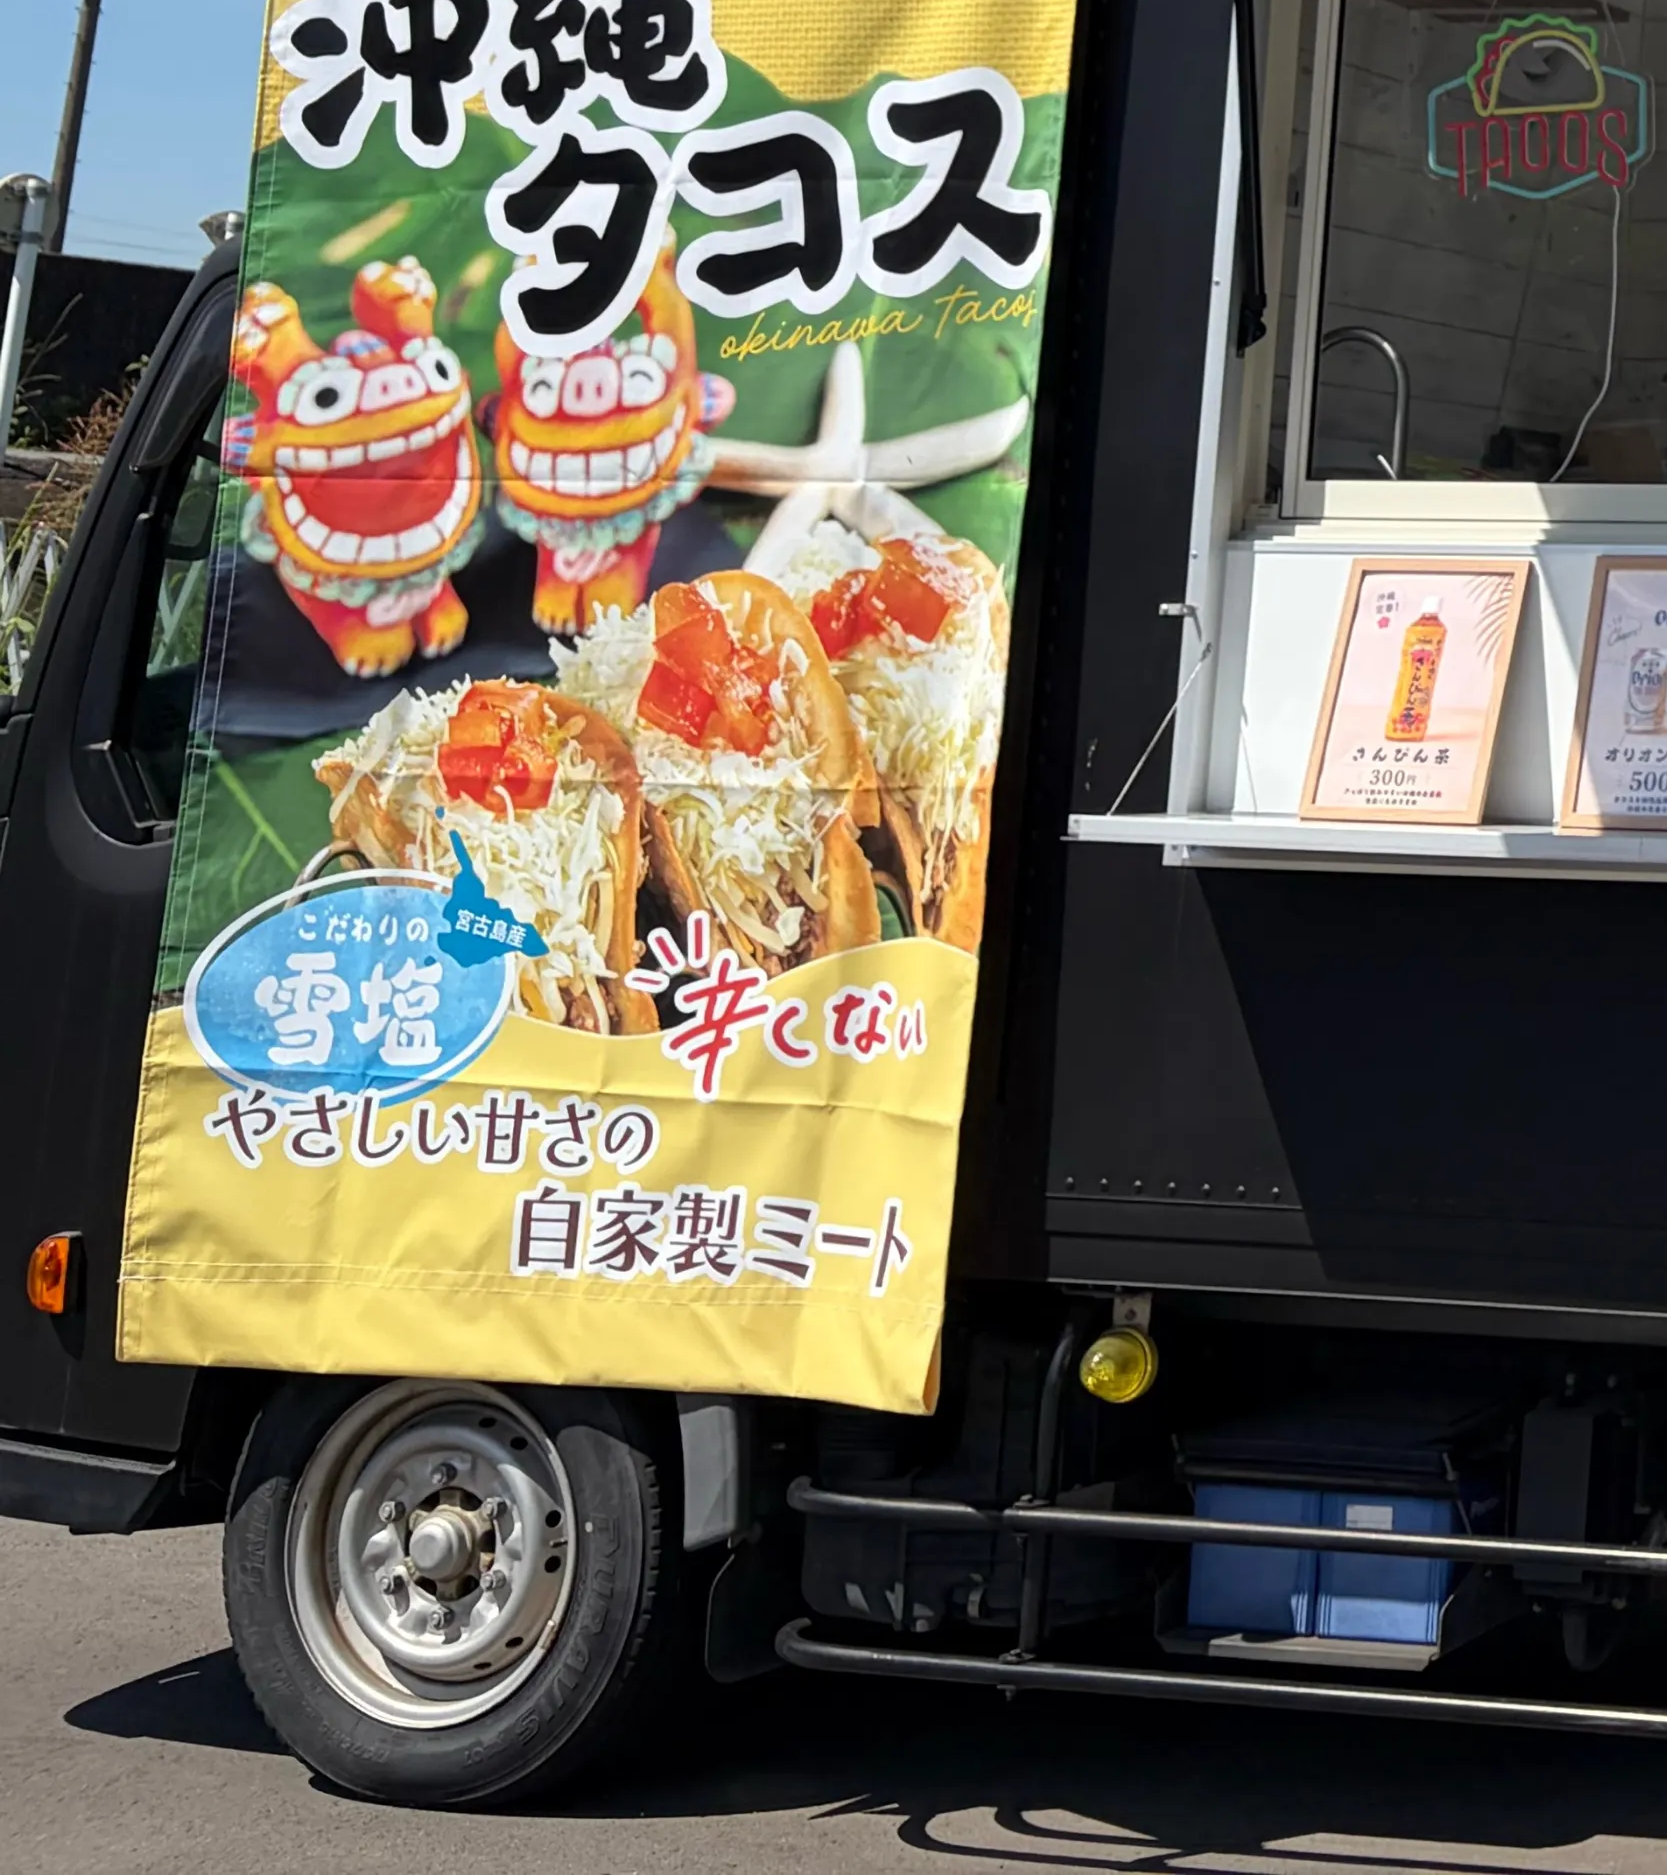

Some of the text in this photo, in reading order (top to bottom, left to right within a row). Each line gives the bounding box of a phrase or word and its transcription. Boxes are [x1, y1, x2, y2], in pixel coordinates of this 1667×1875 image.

[503, 90, 1042, 336] タコス
[720, 311, 924, 361] okinawa
[1369, 769, 1417, 786] 300円
[297, 912, 429, 945] こだわりの
[455, 908, 528, 949] 宮古島産
[253, 951, 444, 1067] 雪塩
[666, 957, 926, 1095] 辛くない
[211, 1093, 657, 1165] やさしい甘さの
[517, 1185, 910, 1292] 自家製ミート
